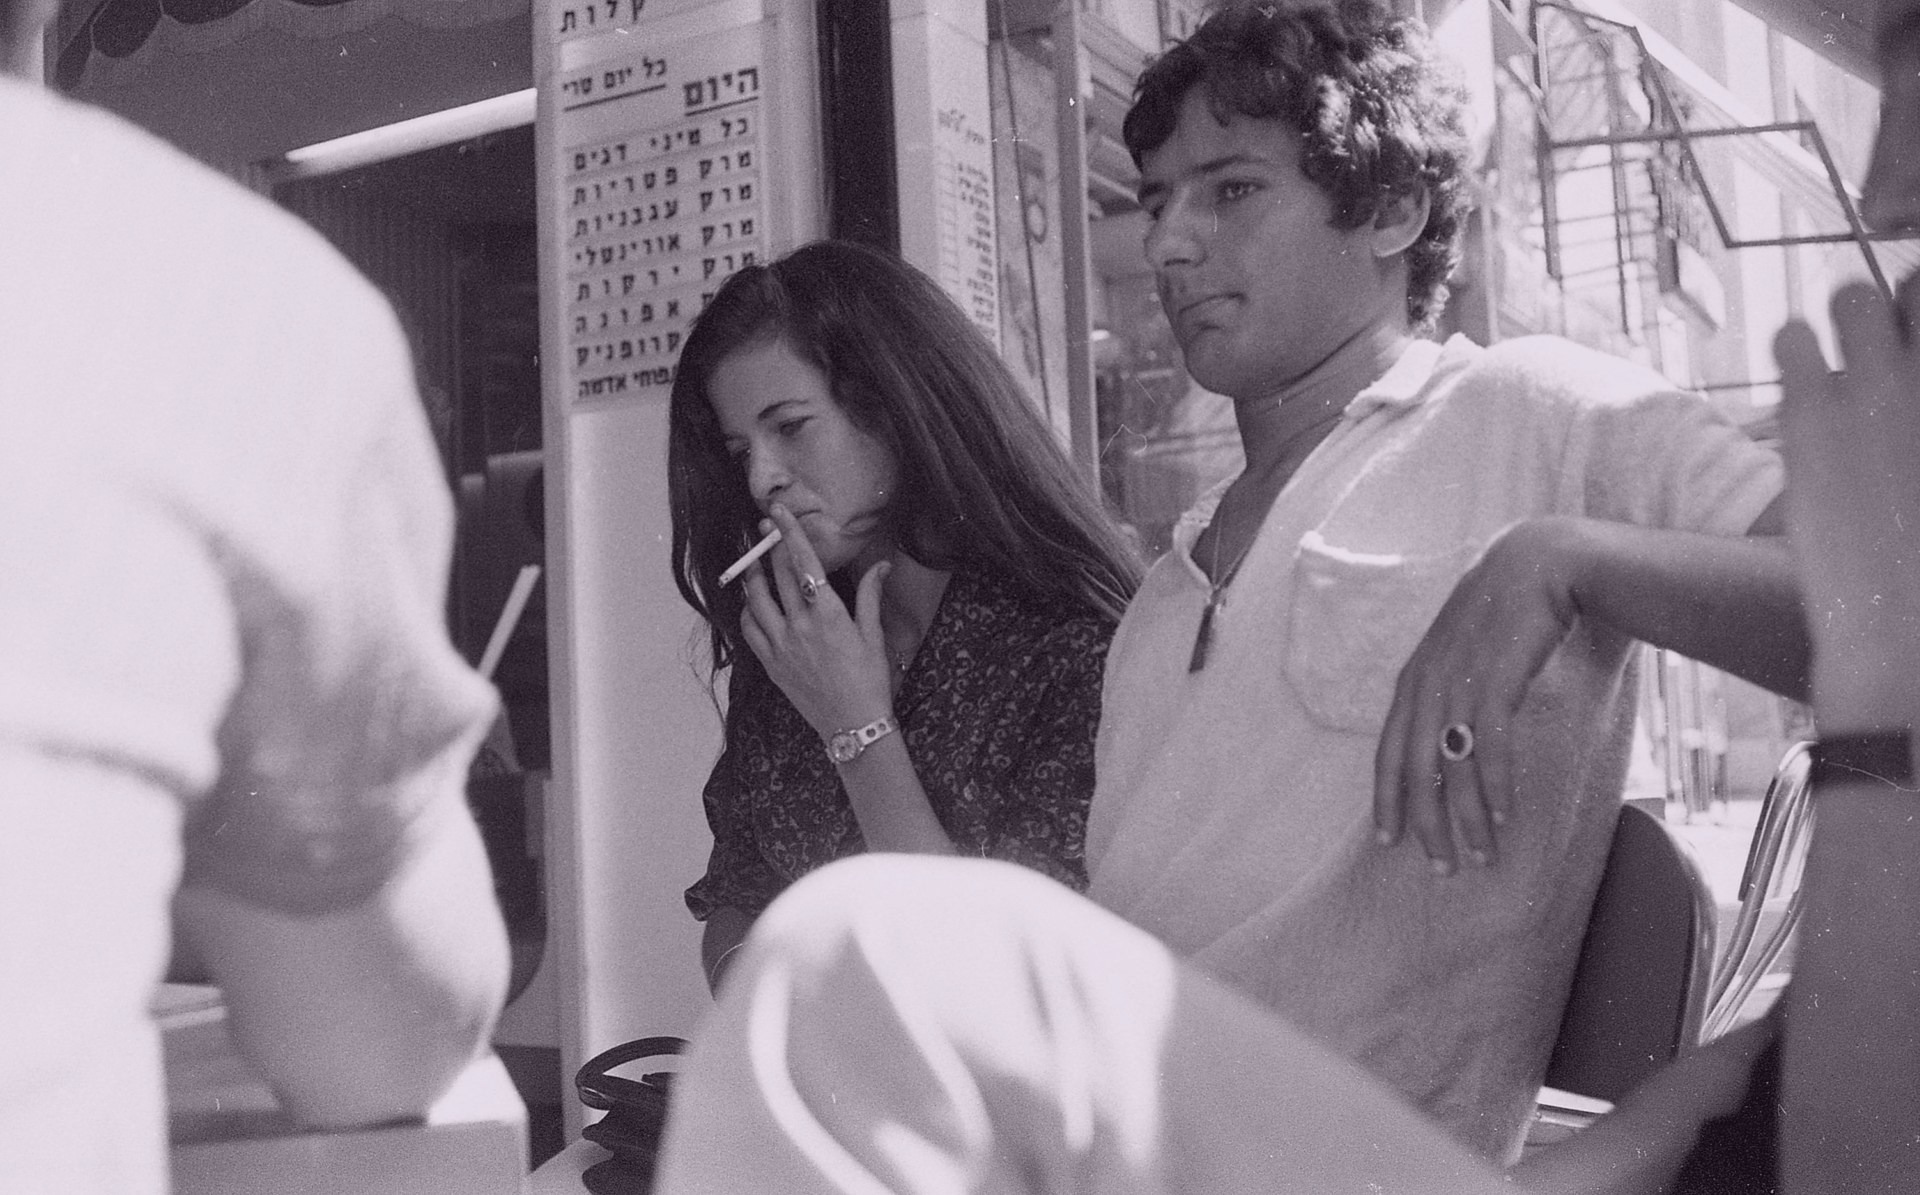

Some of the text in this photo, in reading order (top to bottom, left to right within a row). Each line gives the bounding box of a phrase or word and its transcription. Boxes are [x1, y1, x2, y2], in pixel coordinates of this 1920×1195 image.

[563, 57, 667, 95] כל יום טרי
[684, 66, 758, 107] היום
[651, 129, 701, 151] מיני
[721, 118, 748, 138] כל
[573, 151, 751, 205] מרק פטריות
[700, 184, 752, 212] מרק
[575, 219, 753, 266] מרק אורינטלי
[703, 252, 754, 280] מרק
[577, 265, 680, 302] ירקות
[576, 301, 680, 334] אפונה
[577, 332, 680, 367] קרופניק
[578, 373, 627, 398] אדמה
